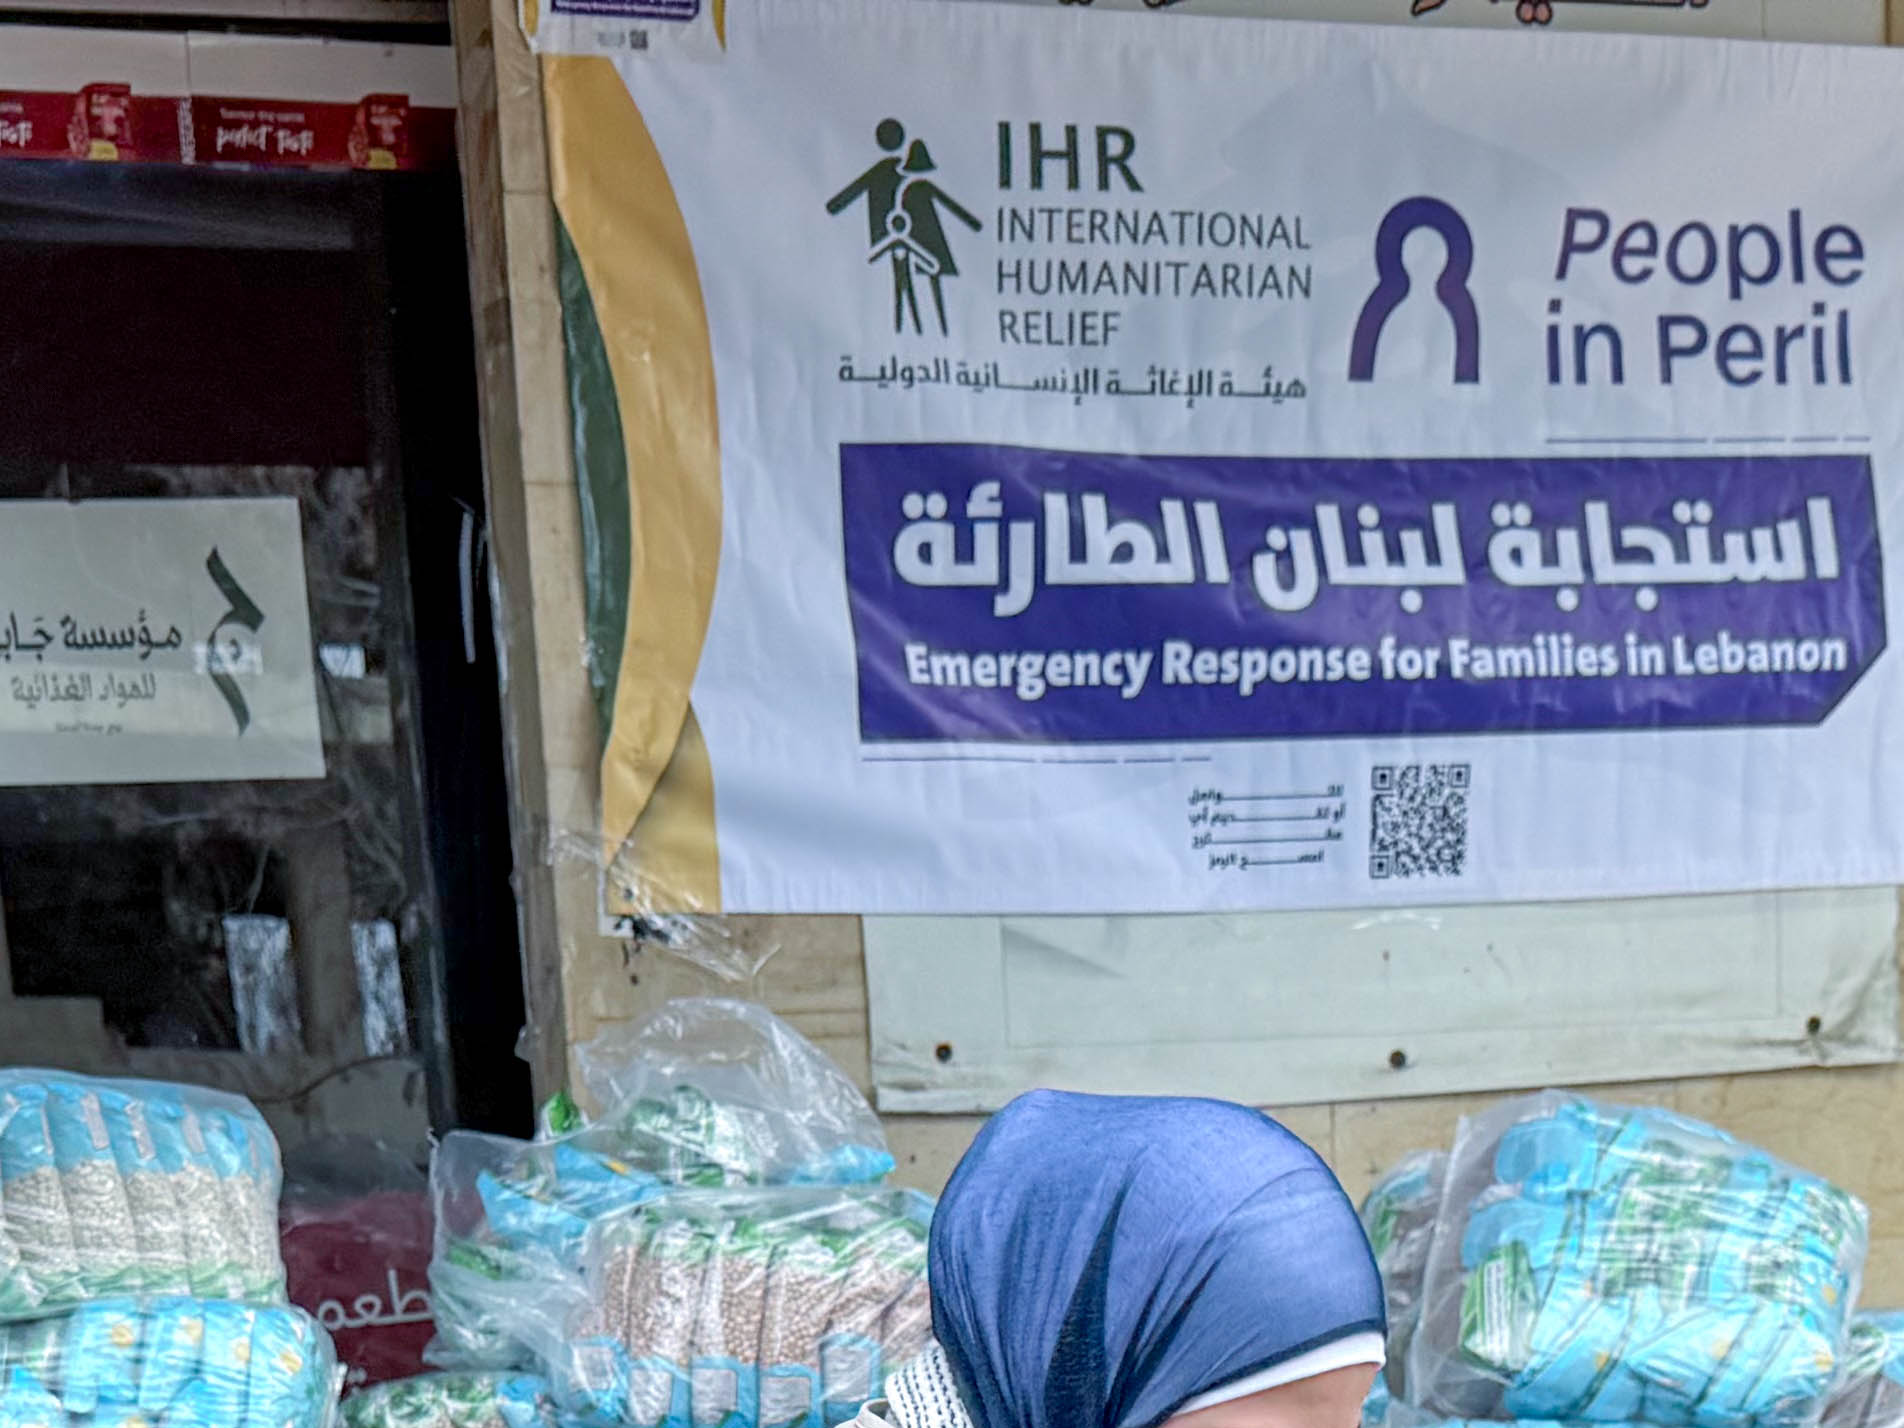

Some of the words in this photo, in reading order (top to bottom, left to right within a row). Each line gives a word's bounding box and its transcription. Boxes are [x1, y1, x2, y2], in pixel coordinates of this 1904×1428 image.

[998, 121, 1144, 192] IHR
[997, 206, 1309, 250] INTERNATIONAL
[1555, 206, 1865, 301] People
[997, 259, 1312, 299] HUMANITARIAN
[998, 309, 1121, 347] RELIEF
[1547, 298, 1624, 386] in
[1657, 302, 1852, 387] Peril
[894, 481, 1231, 617] الطارئة
[1253, 504, 1466, 613] لبنان
[1488, 498, 1836, 612] استجابة
[62, 609, 182, 661] مؤسسة
[904, 643, 1154, 700] Emergency
[1162, 641, 1371, 695] Response
[1379, 635, 1441, 680] for
[1448, 634, 1617, 678] Families
[1625, 634, 1665, 675] in
[1672, 634, 1847, 675] Lebanon
